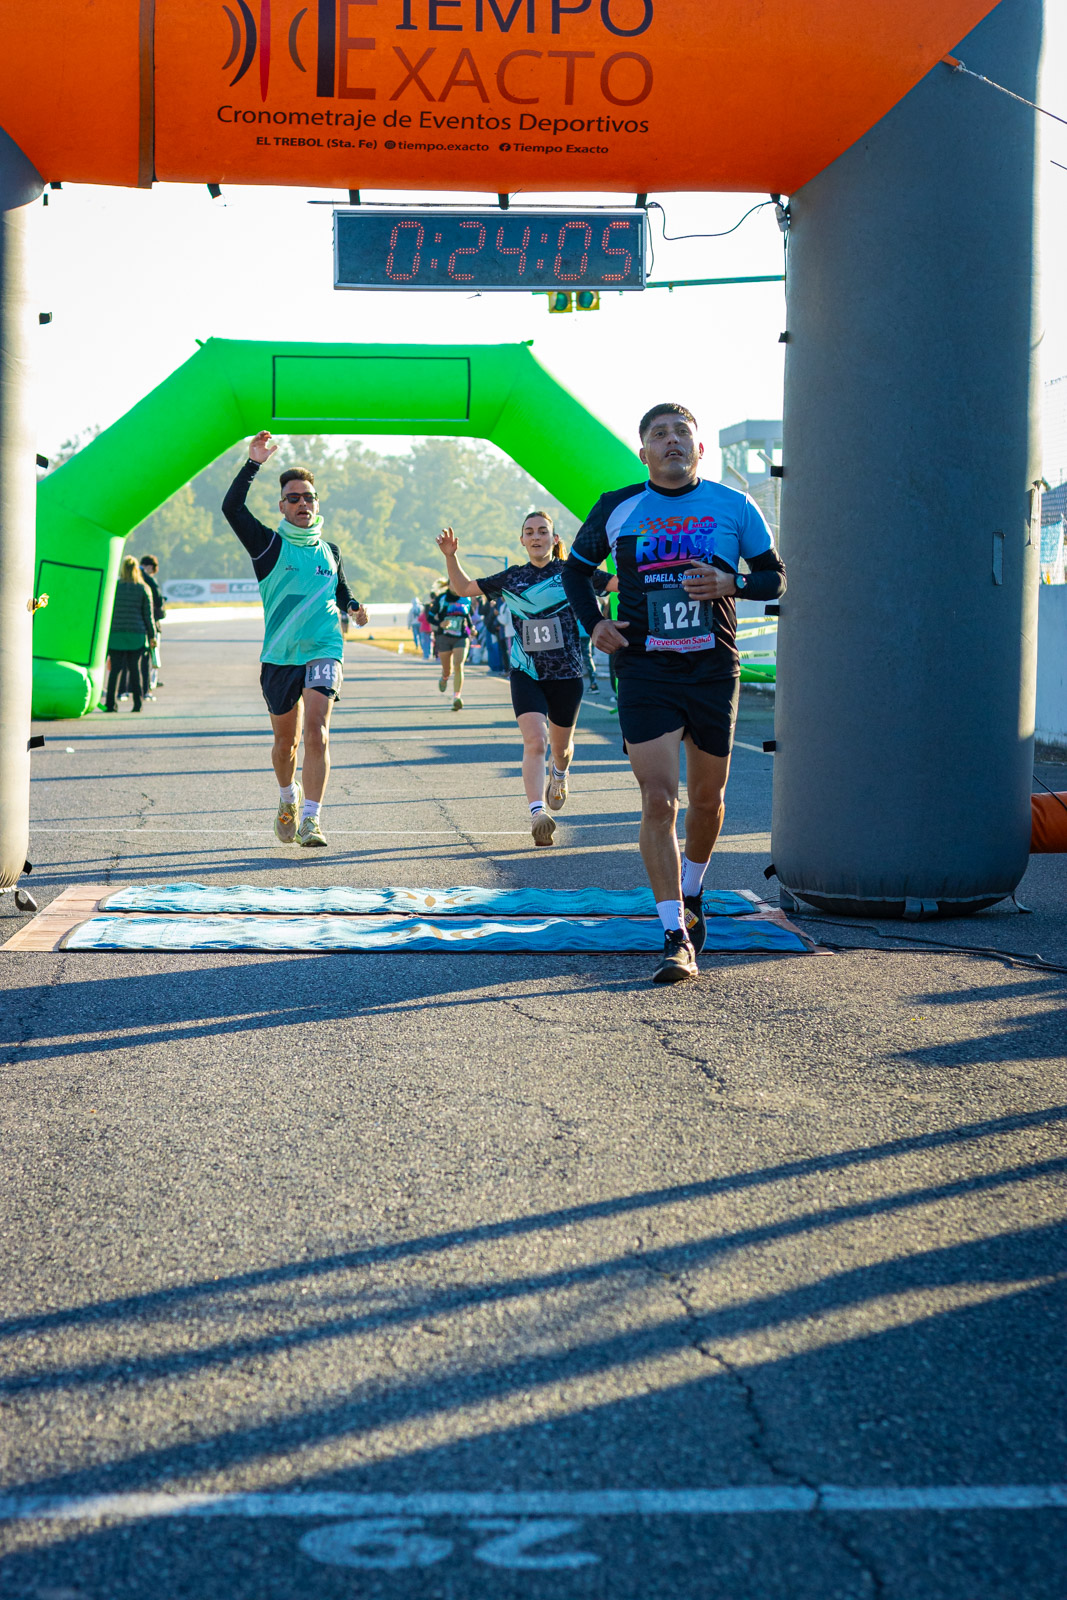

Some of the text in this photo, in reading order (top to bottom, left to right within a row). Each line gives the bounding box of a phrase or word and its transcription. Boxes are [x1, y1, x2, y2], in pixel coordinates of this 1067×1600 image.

[217, 105, 650, 135] Cronometraje de Eventos Deportivos
[256, 136, 271, 146] EL
[273, 137, 324, 148] TREBOL
[326, 138, 356, 149] (Sta.
[358, 139, 378, 150] Fe)
[513, 143, 563, 155] Tiempo
[566, 144, 609, 154] Exacto
[386, 221, 632, 280] 0:24:05
[644, 572, 676, 584] RAFAELA,
[662, 600, 701, 630] 127
[533, 625, 551, 644] 13
[692, 633, 712, 645] Salud
